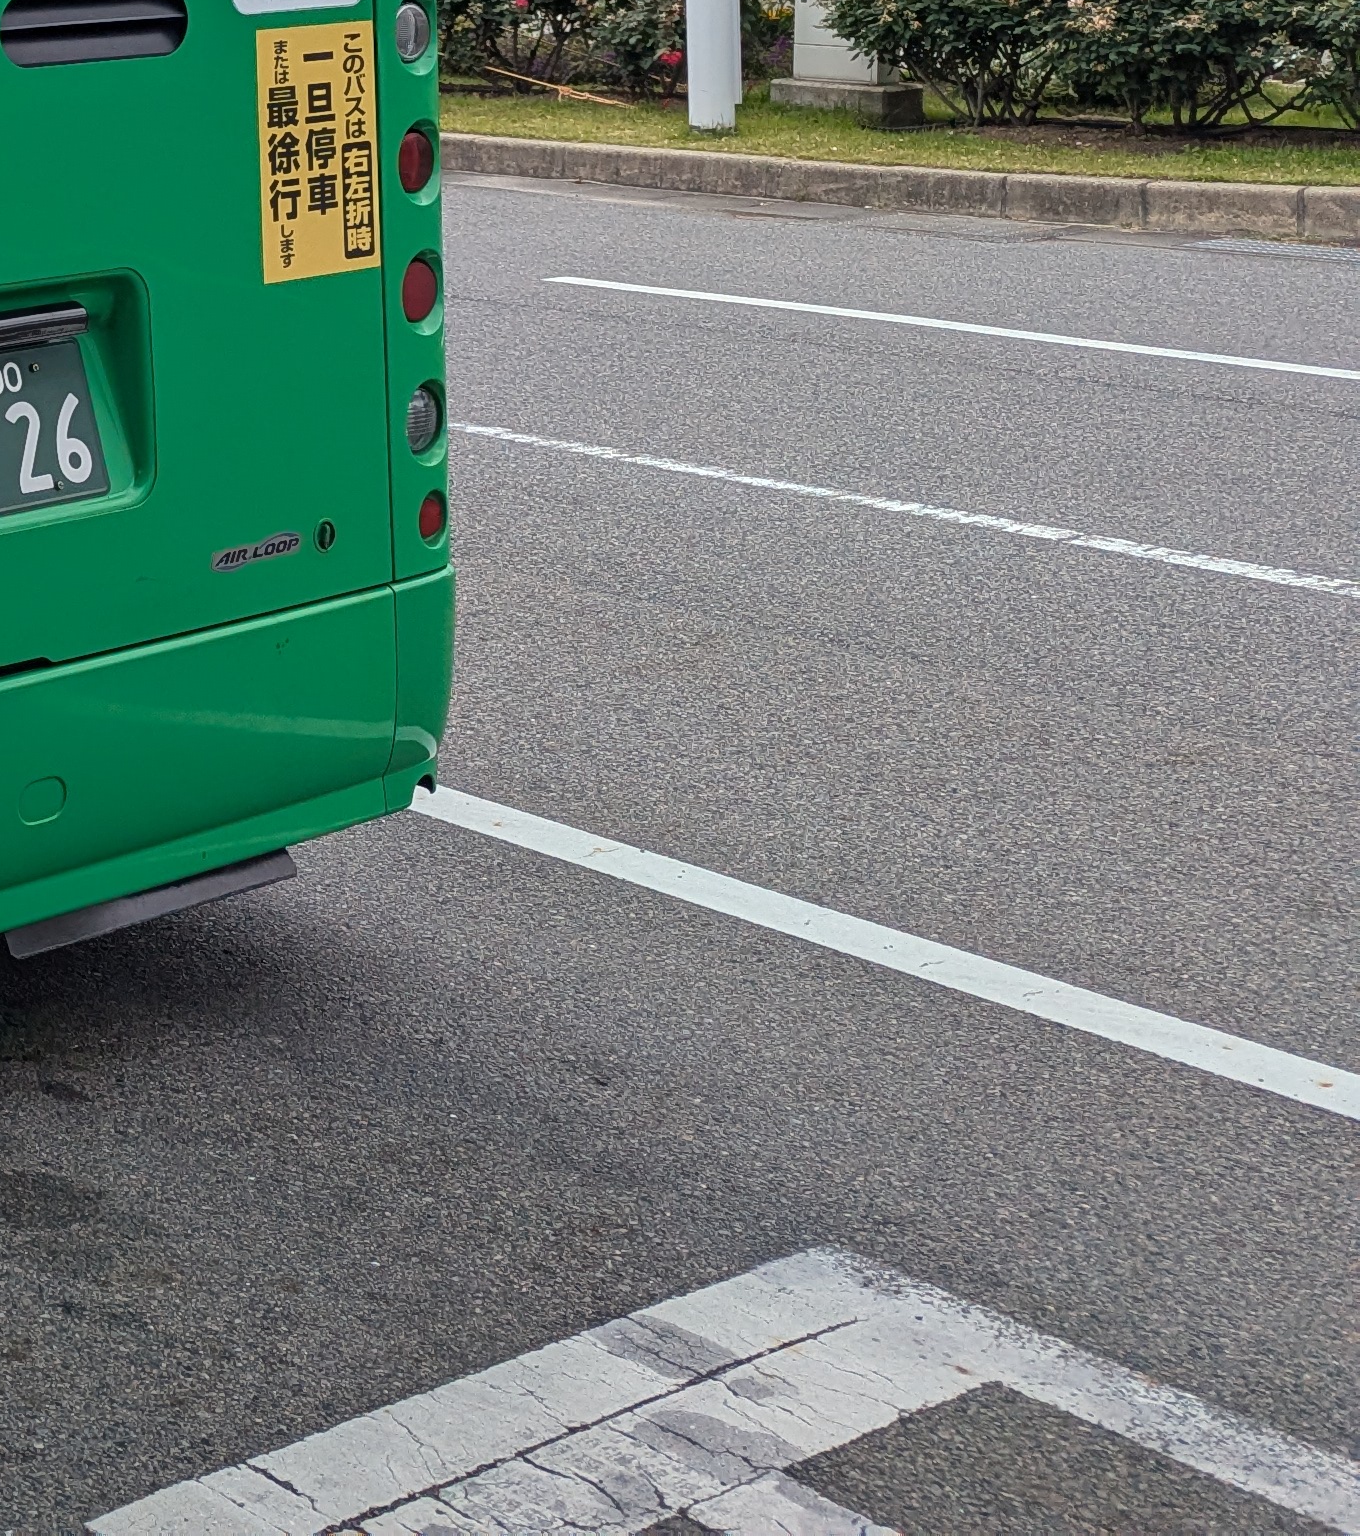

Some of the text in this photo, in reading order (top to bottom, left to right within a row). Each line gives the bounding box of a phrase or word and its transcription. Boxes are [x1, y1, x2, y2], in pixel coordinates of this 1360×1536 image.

[302, 50, 339, 216] 一旦停車
[215, 537, 300, 568] AIR LOOP
